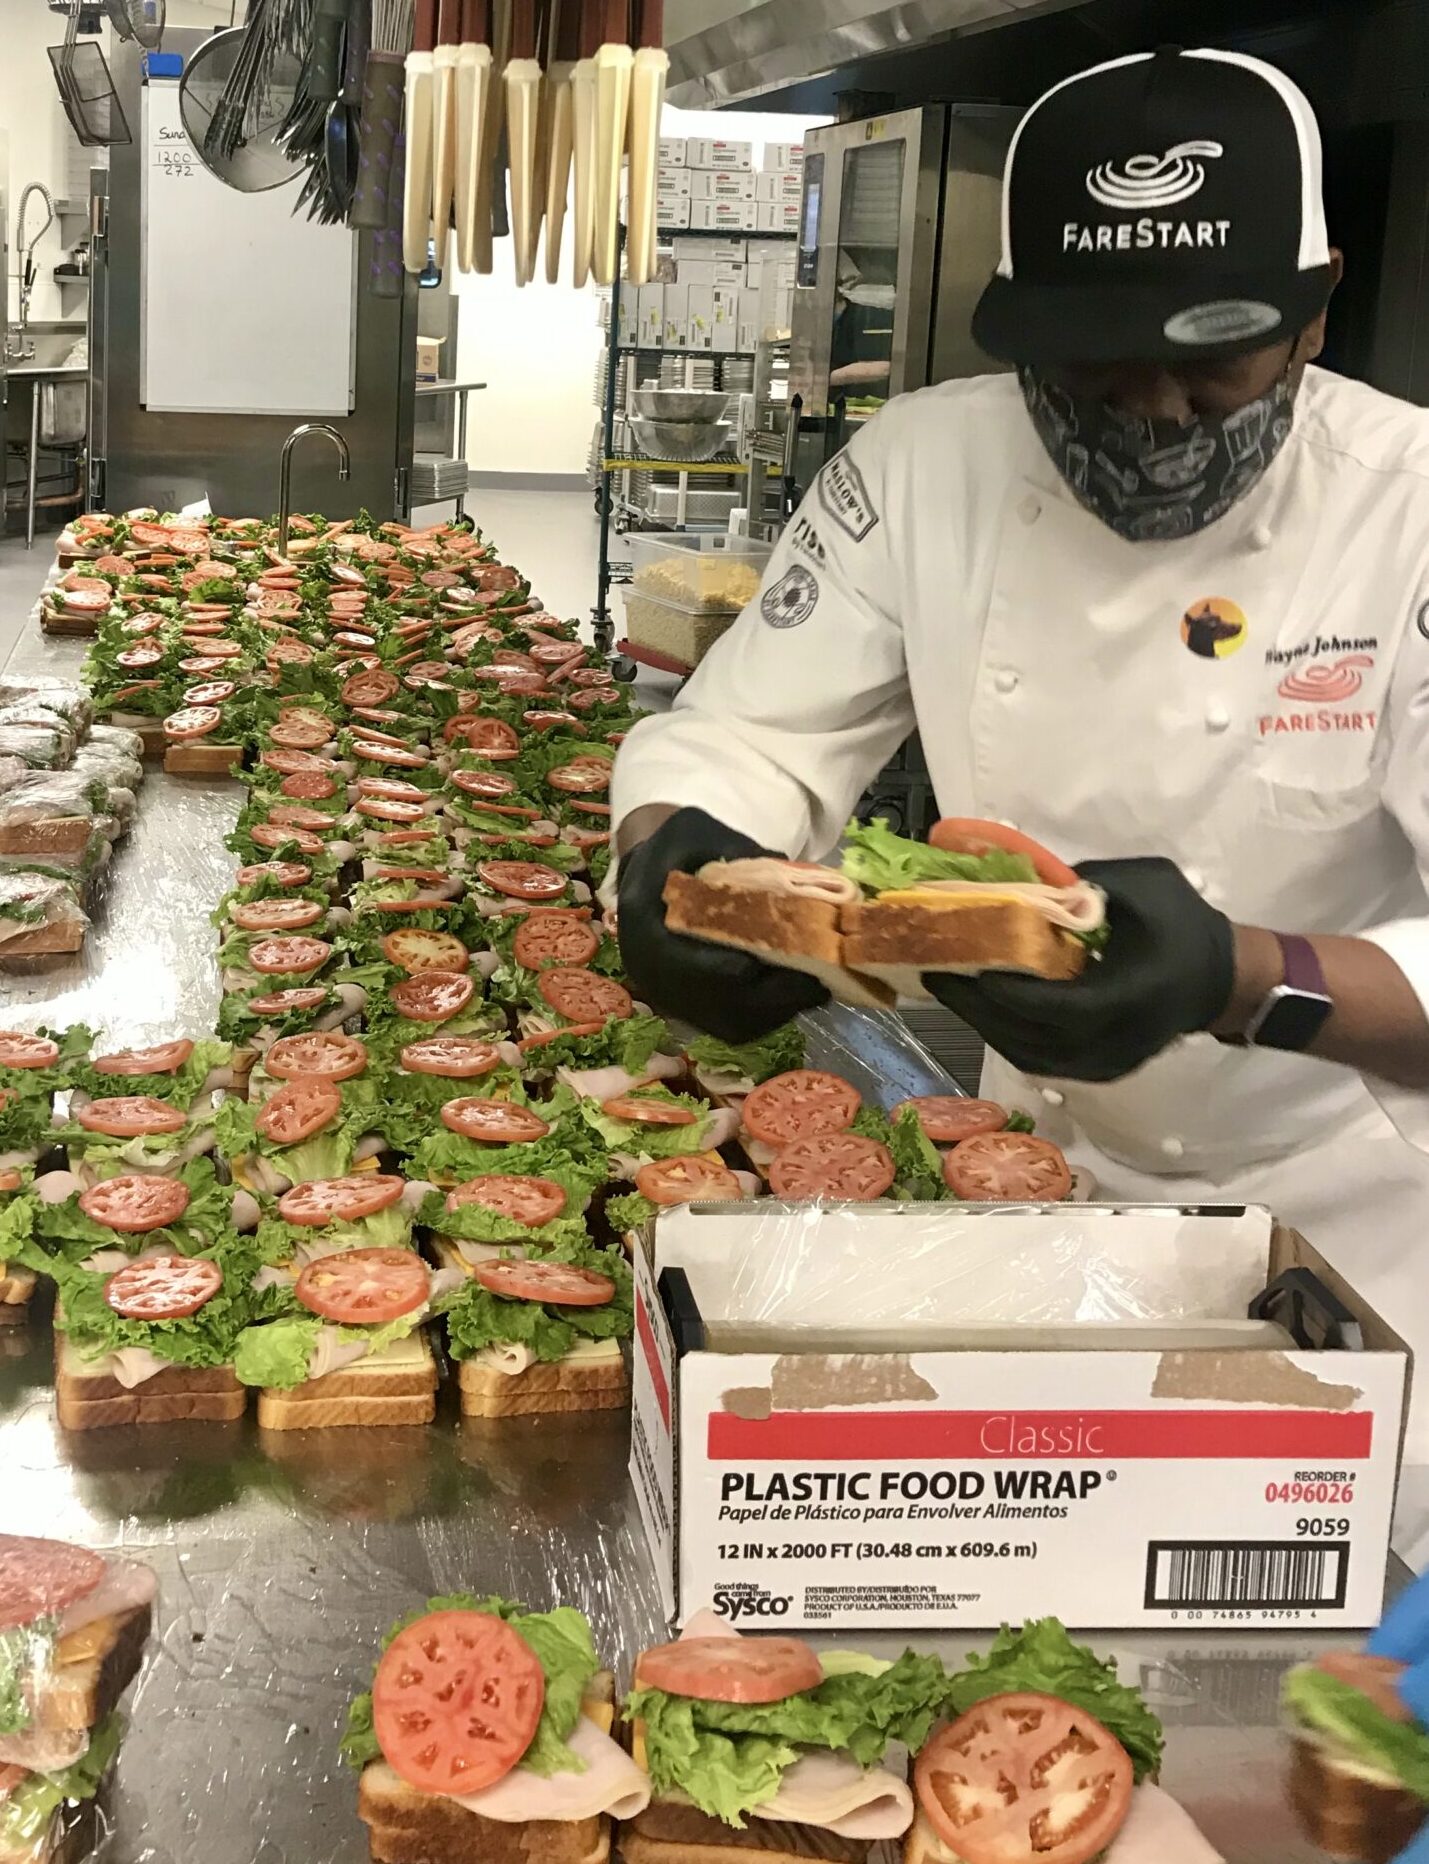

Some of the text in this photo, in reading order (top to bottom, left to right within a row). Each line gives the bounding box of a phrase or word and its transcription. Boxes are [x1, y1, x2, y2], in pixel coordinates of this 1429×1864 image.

[158, 151, 192, 164] 1200
[164, 164, 194, 177] 272
[1062, 217, 1231, 253] FARESTART
[1311, 635, 1377, 658] Johnson
[980, 1415, 1105, 1454] Classic
[721, 1470, 1102, 1501] PLASTIC FOOD WRAP
[1293, 1471, 1348, 1482] REORDER
[1264, 1482, 1354, 1503] 0496026
[718, 1502, 1068, 1524] Papel de Plástico para Envolver Alimentos
[1295, 1518, 1350, 1536] 9059
[718, 1541, 1037, 1560] 12 IN x 2000 FT (30.48 cm x 609.6 m)
[714, 1582, 735, 1591] Good
[713, 1591, 791, 1621] Sysco
[1171, 1610, 1317, 1619] 0 00 74865 94795 4
